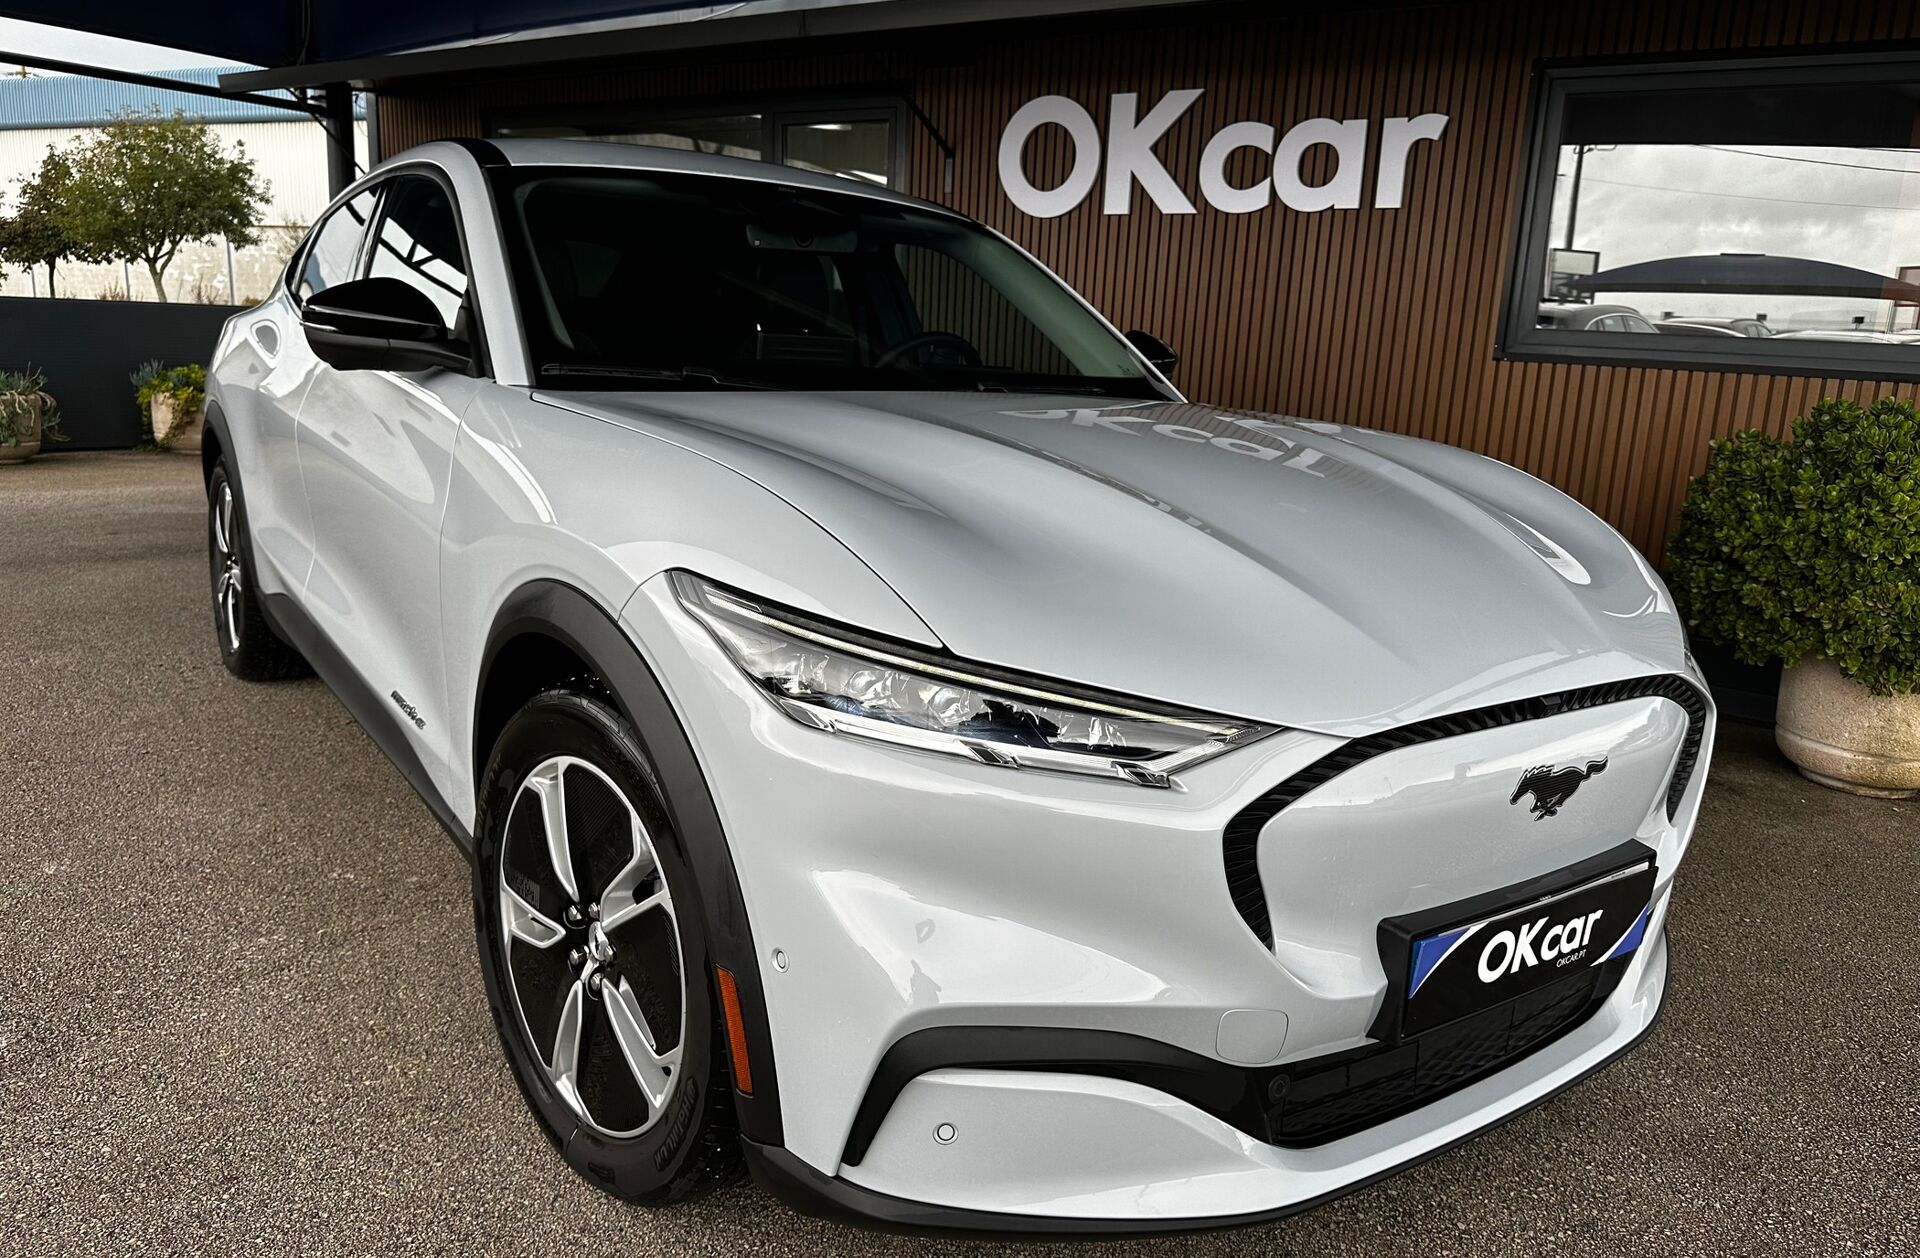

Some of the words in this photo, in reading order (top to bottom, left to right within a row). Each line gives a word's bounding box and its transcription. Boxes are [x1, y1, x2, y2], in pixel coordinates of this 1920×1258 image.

[998, 88, 1450, 219] OKcar
[1477, 909, 1604, 984] OKcar
[1556, 948, 1587, 968] OKCAR.PT
